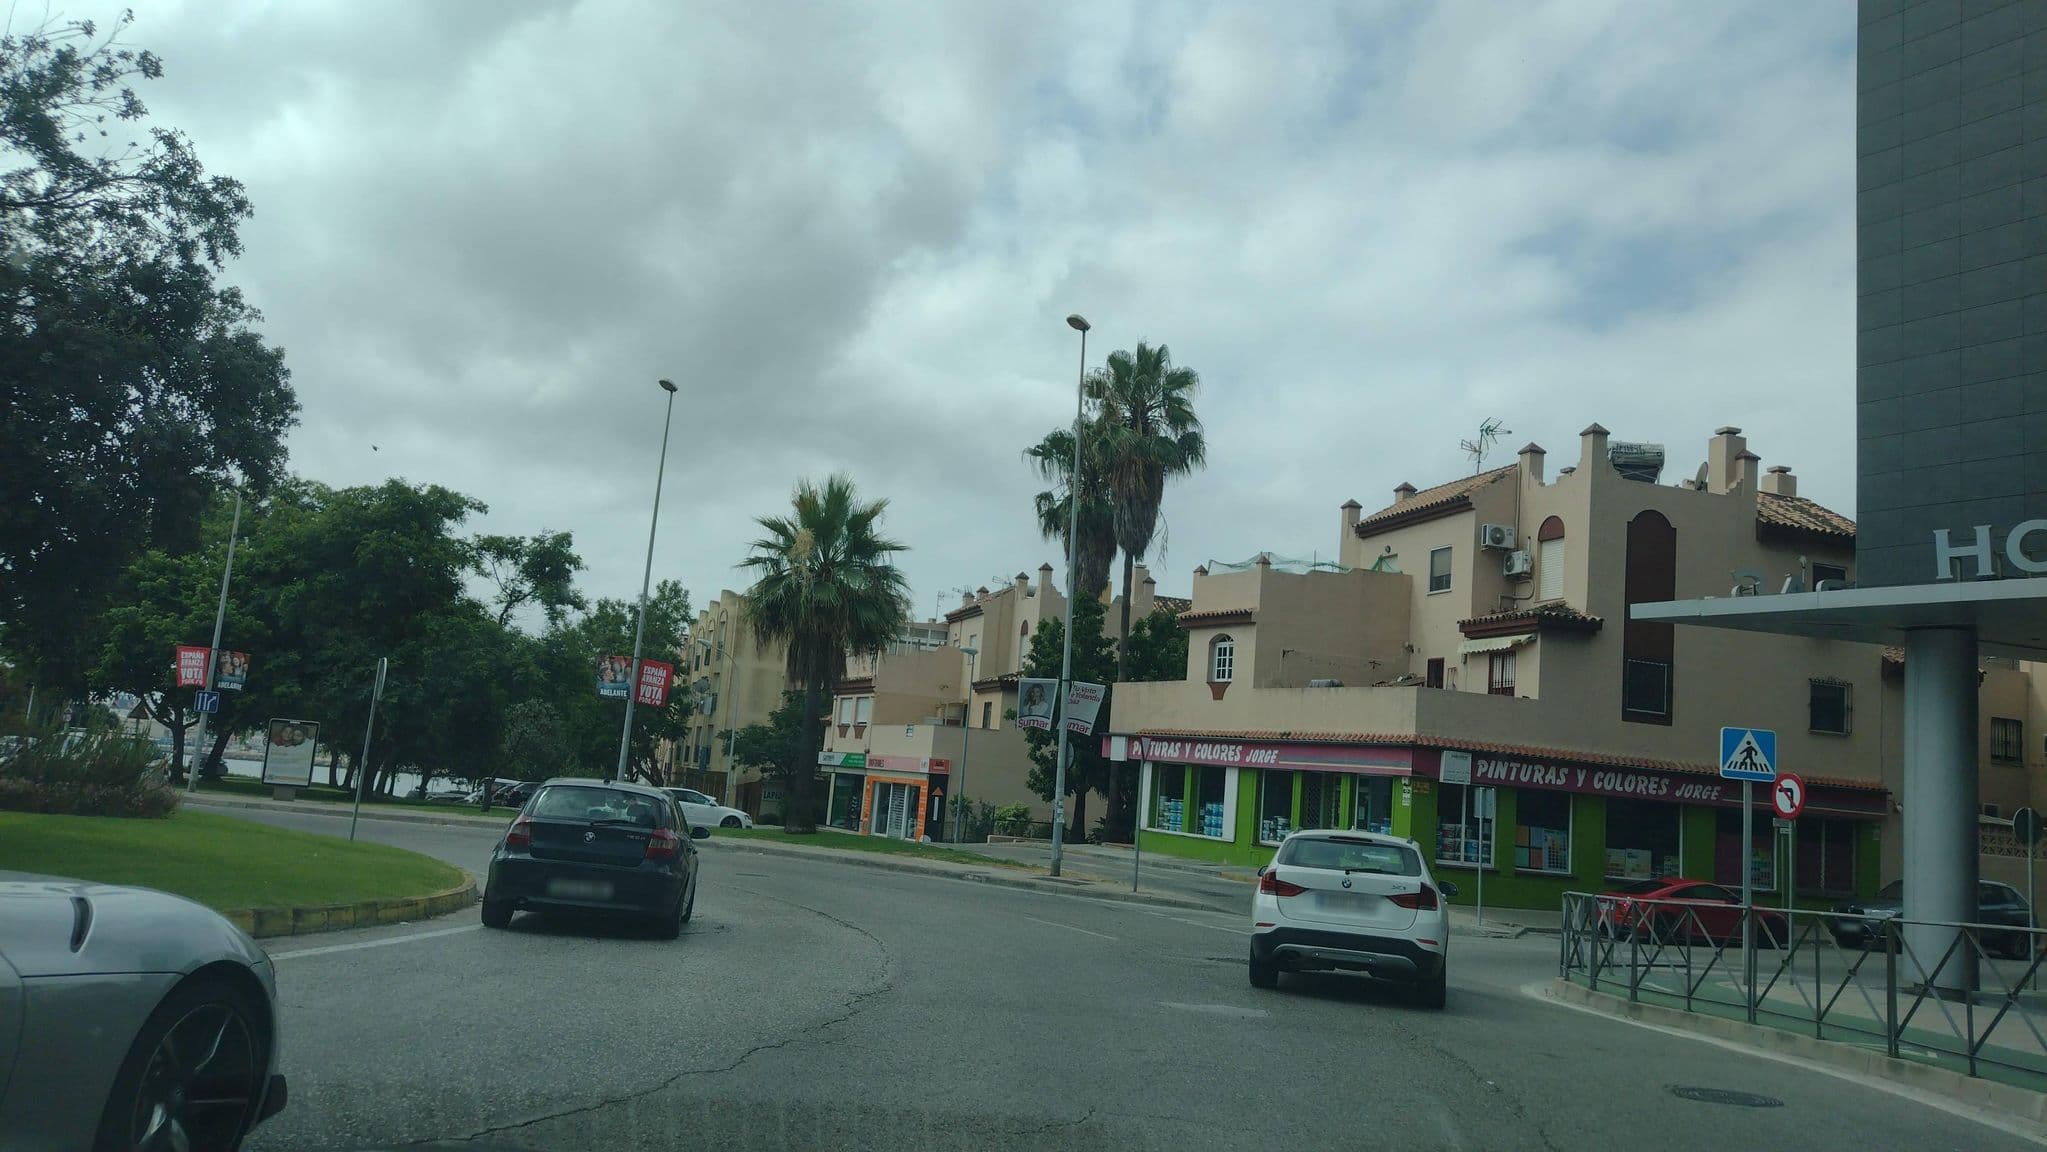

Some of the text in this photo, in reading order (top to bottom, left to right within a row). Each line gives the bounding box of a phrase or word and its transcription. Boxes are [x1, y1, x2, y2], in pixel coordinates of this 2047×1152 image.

[181, 668, 203, 679] VOTA
[643, 665, 667, 678] ESPAÑA
[641, 675, 665, 686] AVANZA
[600, 688, 628, 697] ADELANTE
[640, 684, 662, 700] VOTA
[1018, 718, 1049, 729] sumar
[1067, 720, 1090, 734] mar
[1132, 741, 1279, 765] PITURAS Y COLORES JORGE
[1476, 758, 1569, 786] PINTURAS
[1576, 768, 1586, 788] Y
[1593, 771, 1671, 797] COLORES
[1675, 782, 1722, 800] JORGE
